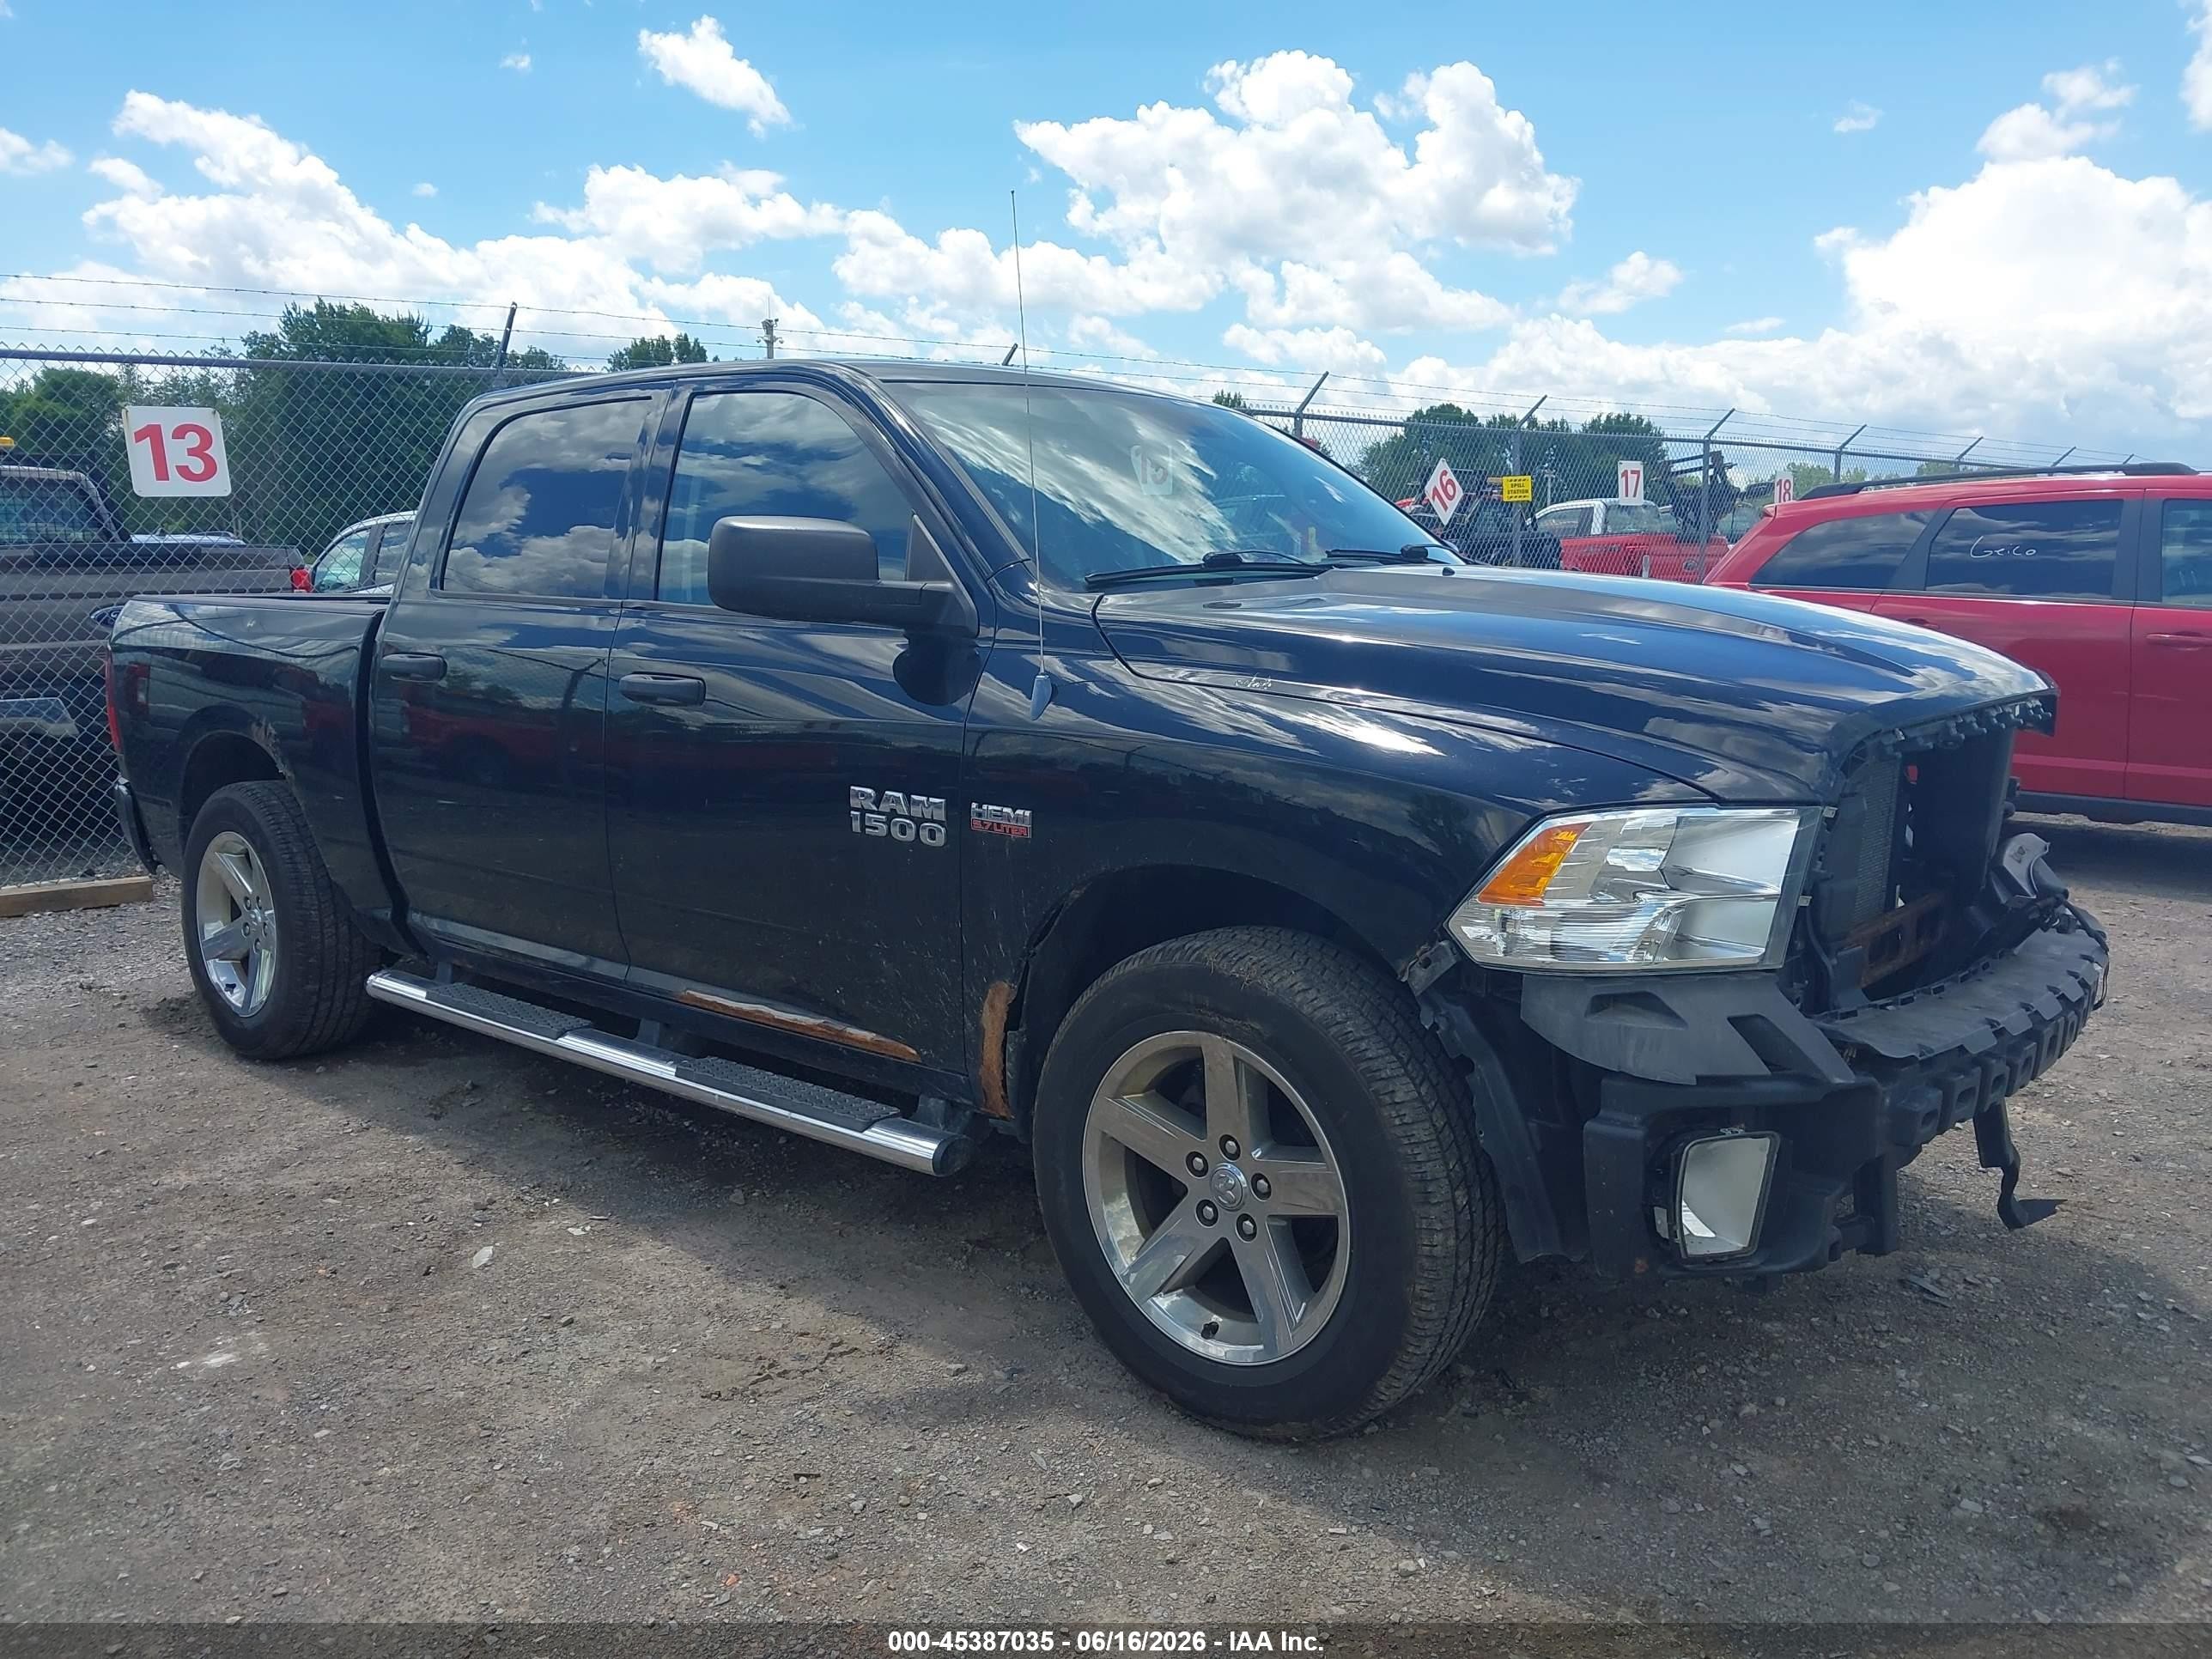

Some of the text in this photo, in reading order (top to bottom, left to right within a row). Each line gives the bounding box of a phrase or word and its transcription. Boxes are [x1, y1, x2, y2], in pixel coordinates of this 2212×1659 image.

[133, 423, 218, 482] 13
[1431, 469, 1456, 512] 16
[1620, 469, 1641, 498] 17
[1776, 478, 1792, 502] 18
[1970, 535, 2037, 558] Geico
[849, 785, 947, 821] RAM
[970, 802, 1032, 826] HEMI
[850, 810, 947, 847] 1500
[972, 818, 1028, 836] 5.7 LITER
